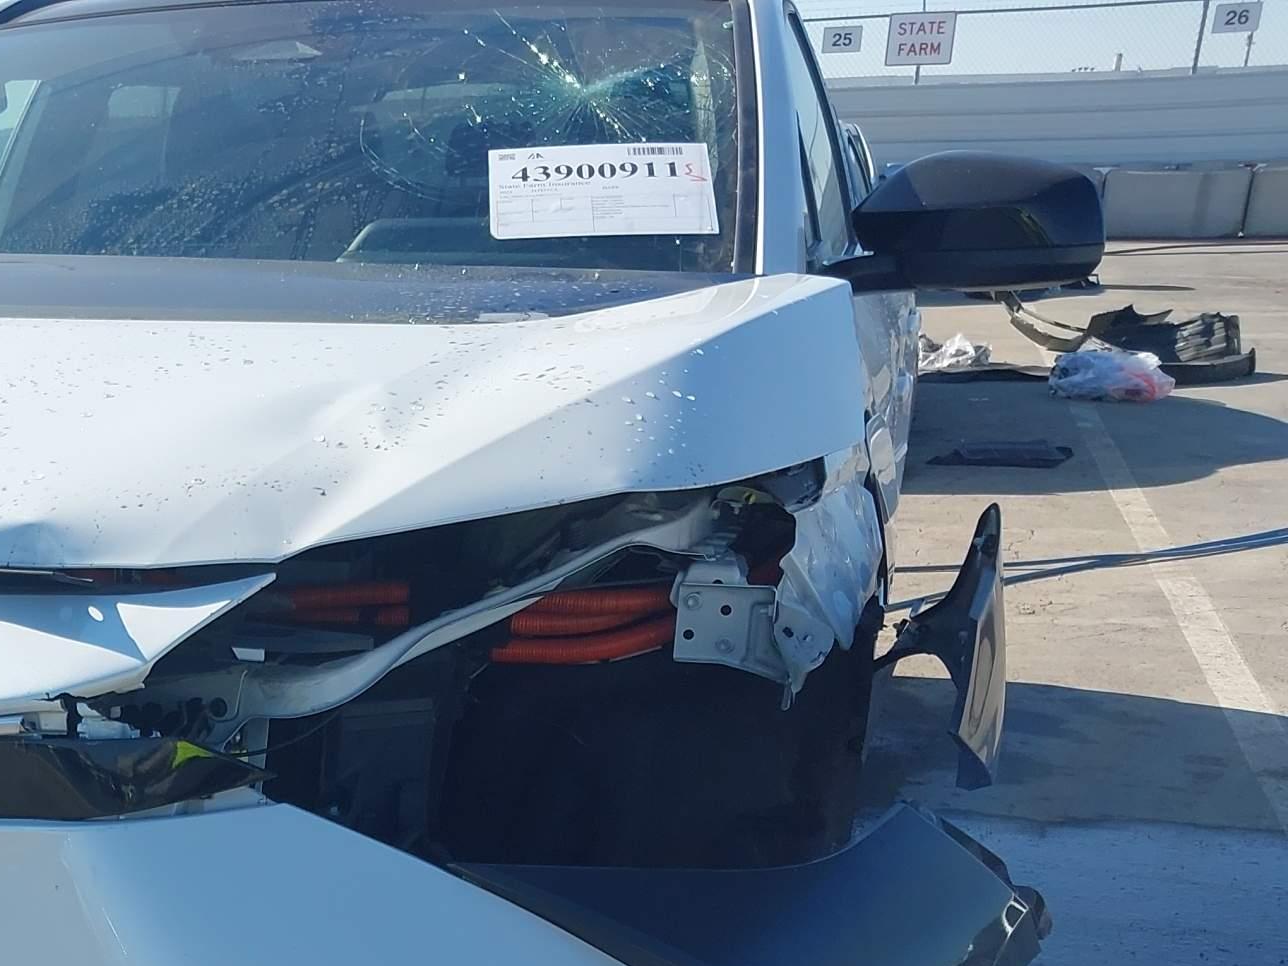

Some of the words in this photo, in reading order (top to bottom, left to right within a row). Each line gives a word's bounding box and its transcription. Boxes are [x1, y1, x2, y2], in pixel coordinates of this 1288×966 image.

[1224, 9, 1250, 26] 26
[897, 21, 947, 36] STATE
[831, 32, 853, 47] 25
[897, 42, 942, 57] FARM
[511, 161, 680, 182] 43900911
